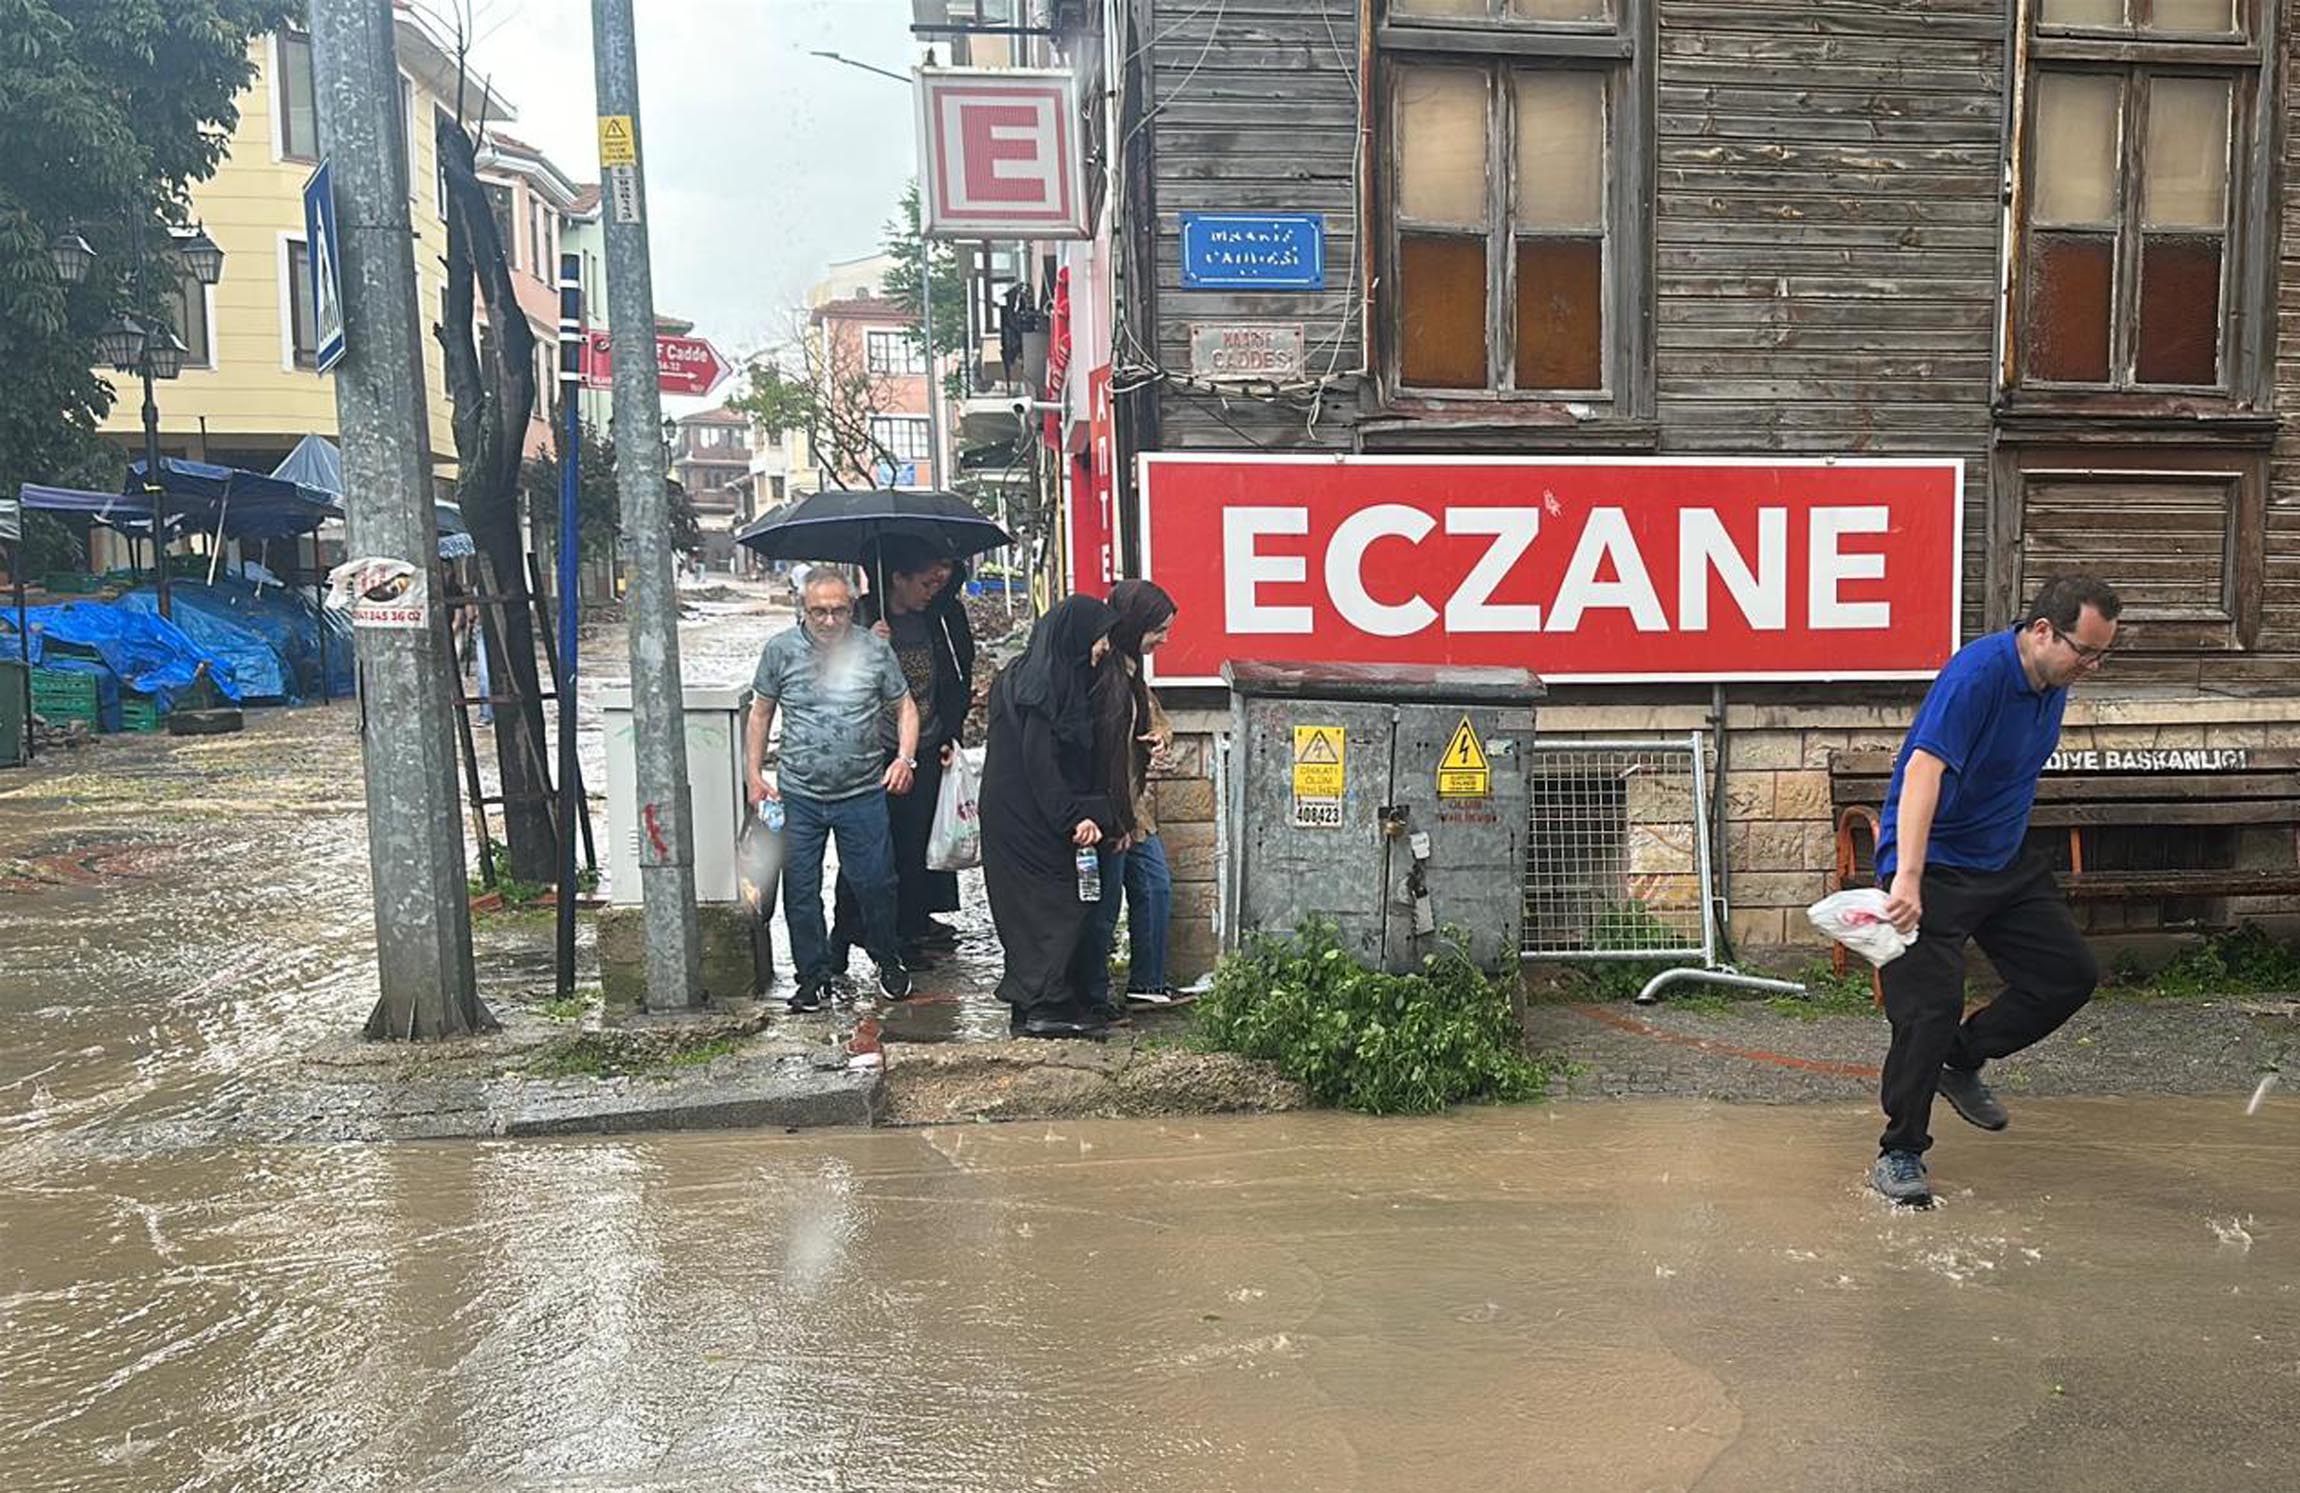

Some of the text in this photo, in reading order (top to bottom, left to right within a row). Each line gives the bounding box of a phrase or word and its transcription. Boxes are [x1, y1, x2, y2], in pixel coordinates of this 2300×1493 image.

[960, 105, 1047, 202] E
[1222, 503, 1890, 637] ECZANE
[1296, 807, 1339, 823] 408423
